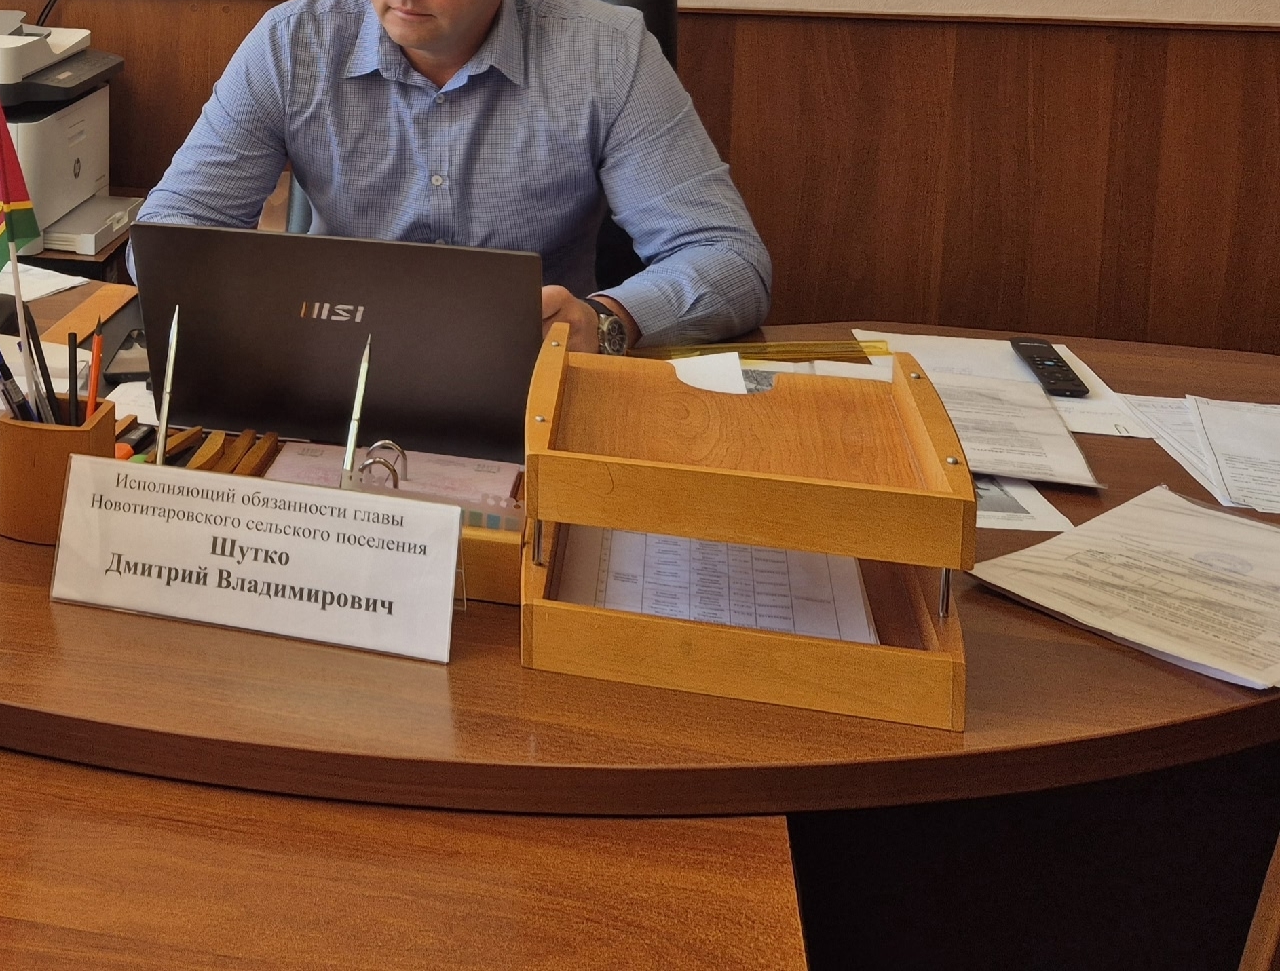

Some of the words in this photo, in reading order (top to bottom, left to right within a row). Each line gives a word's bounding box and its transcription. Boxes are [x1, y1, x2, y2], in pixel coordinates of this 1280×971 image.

[90, 492, 242, 529] Новотитаровского
[245, 518, 331, 542] сельского
[335, 531, 428, 556] поселения
[115, 472, 237, 504] Исполняющий
[240, 491, 348, 519] обязанности
[353, 509, 405, 528] главы
[209, 535, 291, 567] Шутко
[104, 551, 209, 587] Дмитрий
[215, 568, 395, 616] Владимирович
